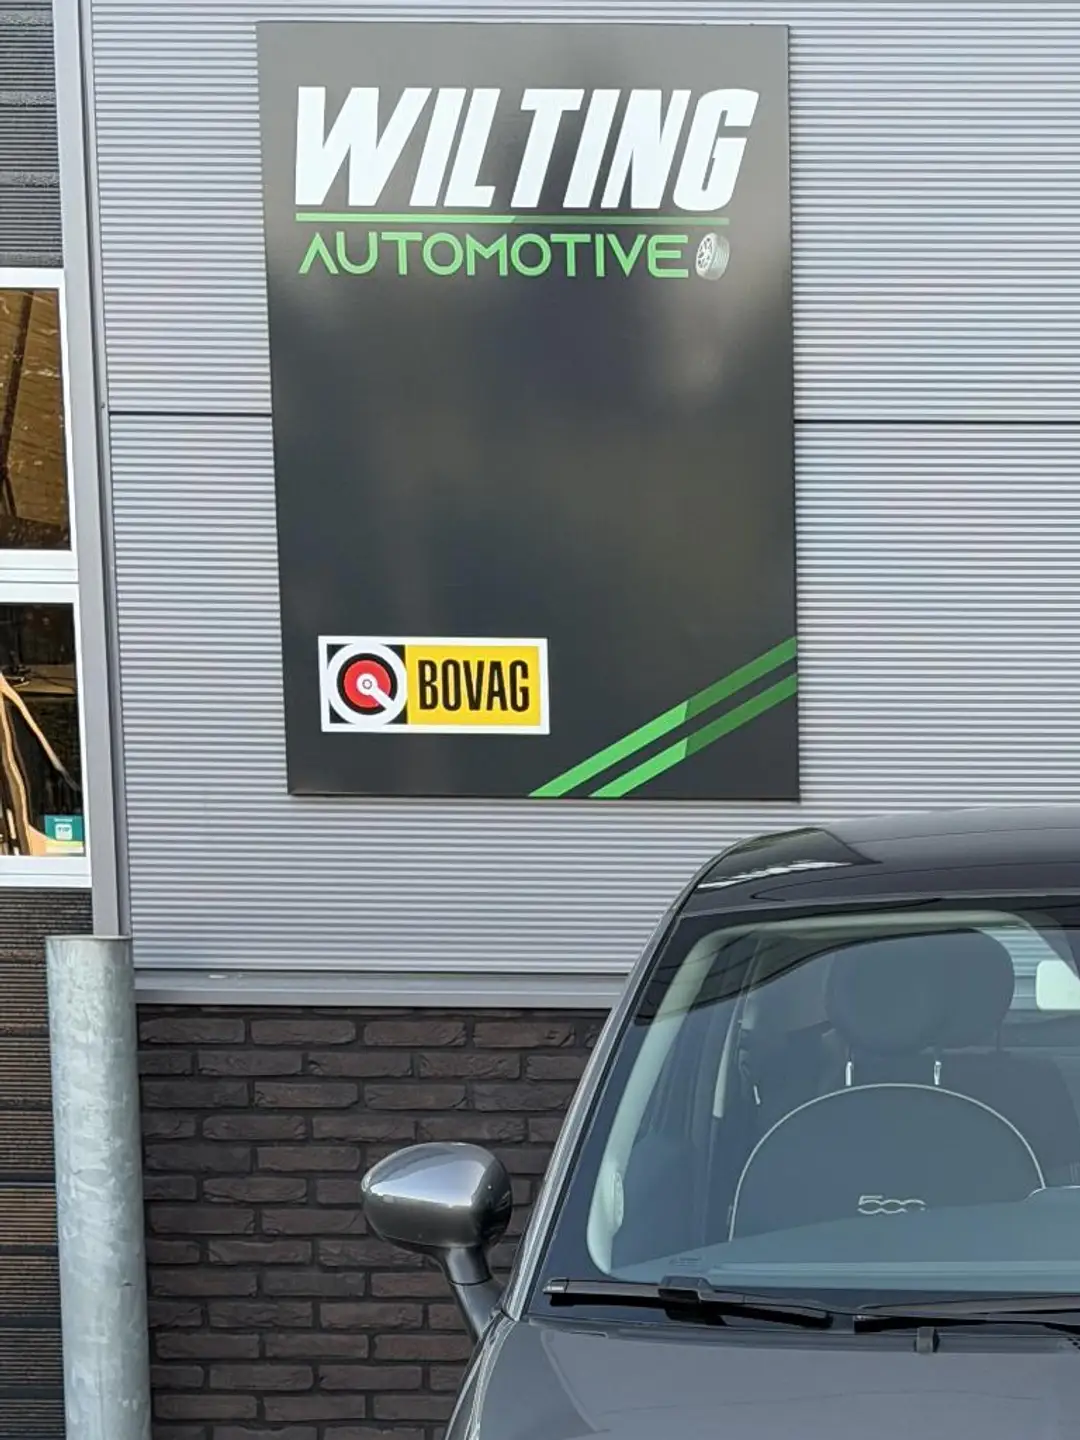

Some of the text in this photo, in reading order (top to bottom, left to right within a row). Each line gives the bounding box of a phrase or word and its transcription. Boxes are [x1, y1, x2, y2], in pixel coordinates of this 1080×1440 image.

[295, 86, 759, 211] WILTING
[299, 231, 689, 278] AUTOMOTIVE
[418, 659, 530, 712] BOVAG
